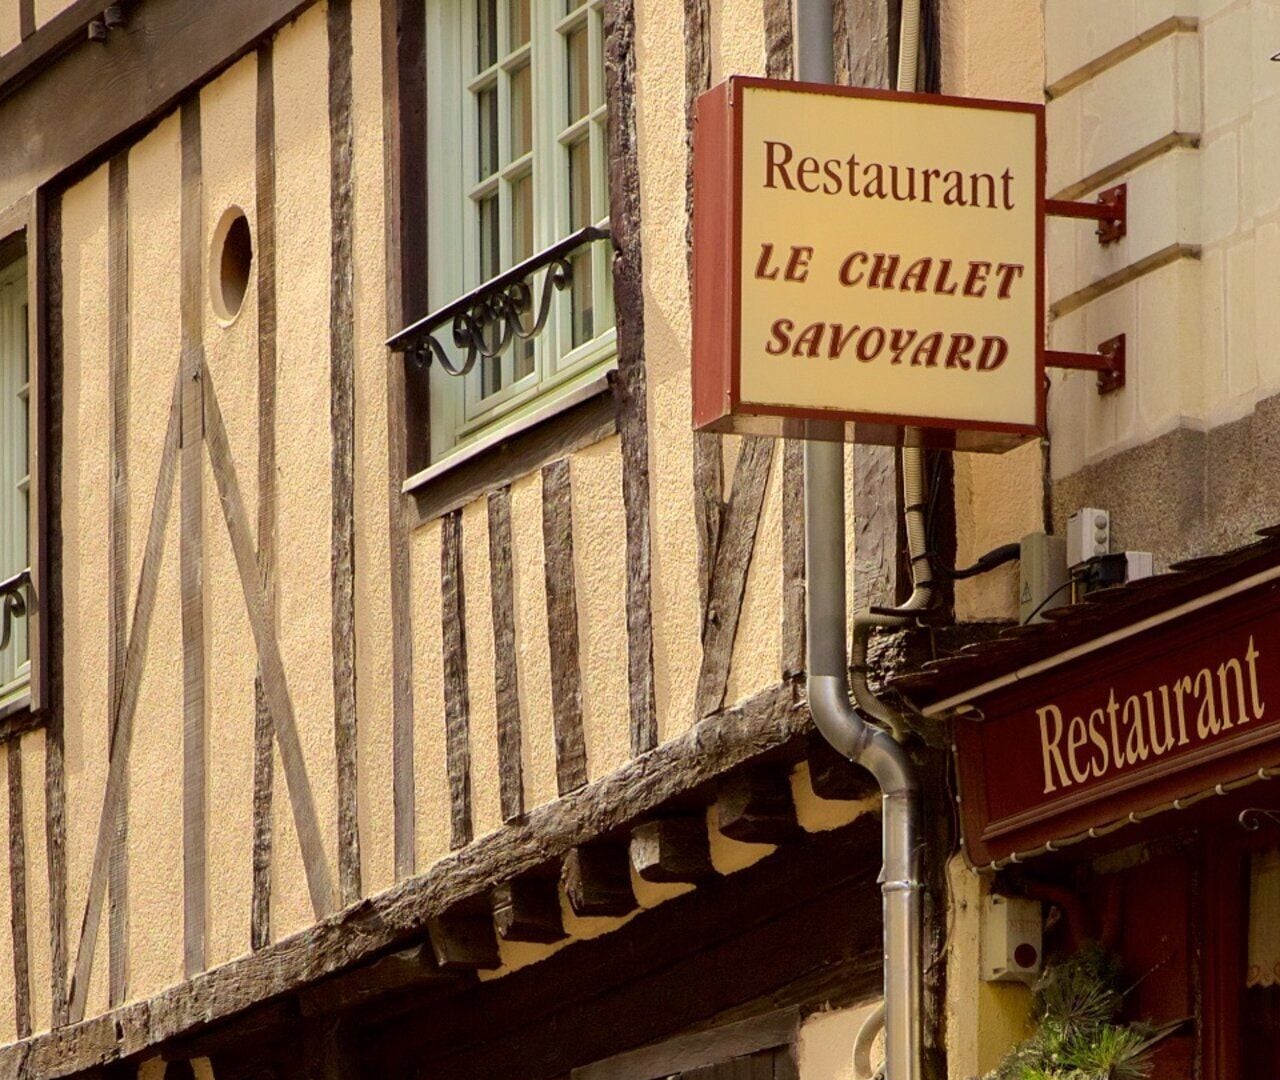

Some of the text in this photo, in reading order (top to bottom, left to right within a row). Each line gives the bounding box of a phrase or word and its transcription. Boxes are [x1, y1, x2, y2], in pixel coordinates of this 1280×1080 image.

[763, 140, 1015, 211] Restaurant
[754, 243, 1024, 300] LE CHALET
[765, 318, 1009, 372] SAVOYARD
[1035, 635, 1265, 795] Restaurant
